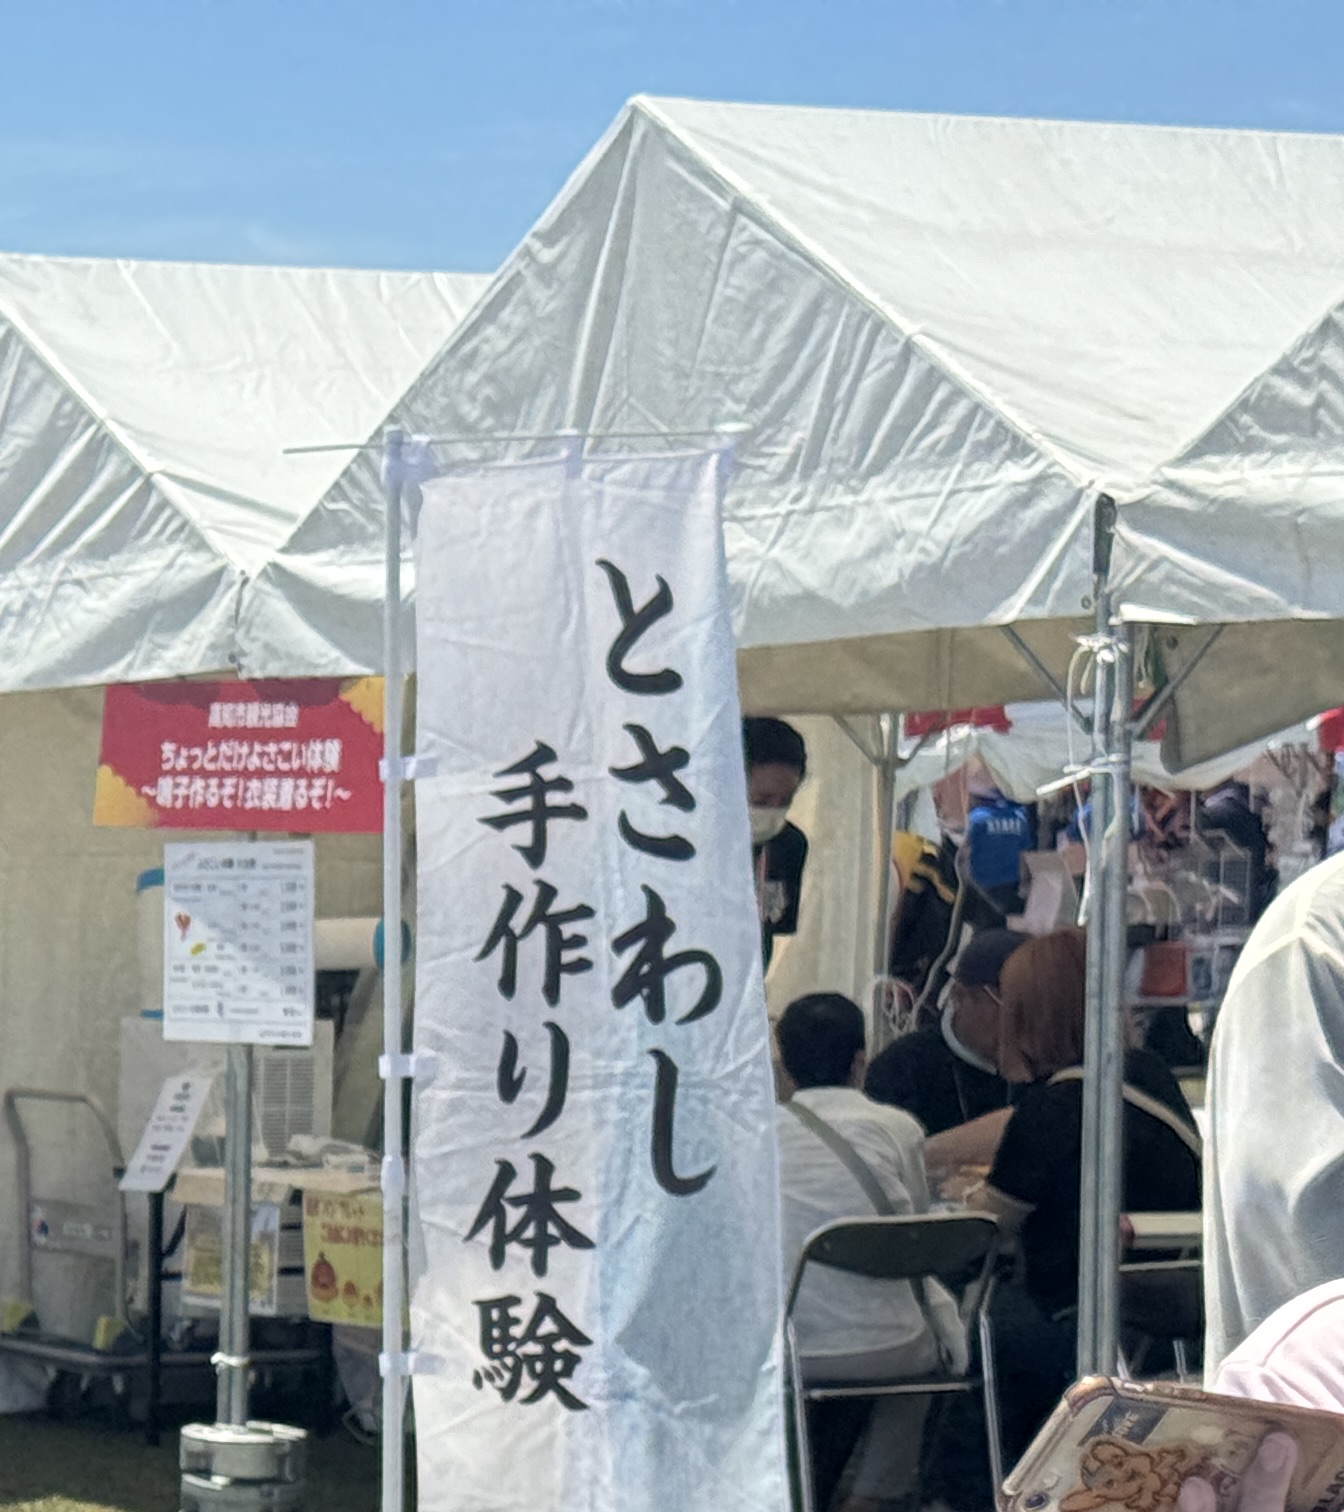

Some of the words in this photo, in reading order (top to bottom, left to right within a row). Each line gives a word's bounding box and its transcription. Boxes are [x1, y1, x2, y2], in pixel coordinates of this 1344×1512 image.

[464, 739, 596, 1412] 手作り体験
[595, 558, 723, 1197] とさわし
